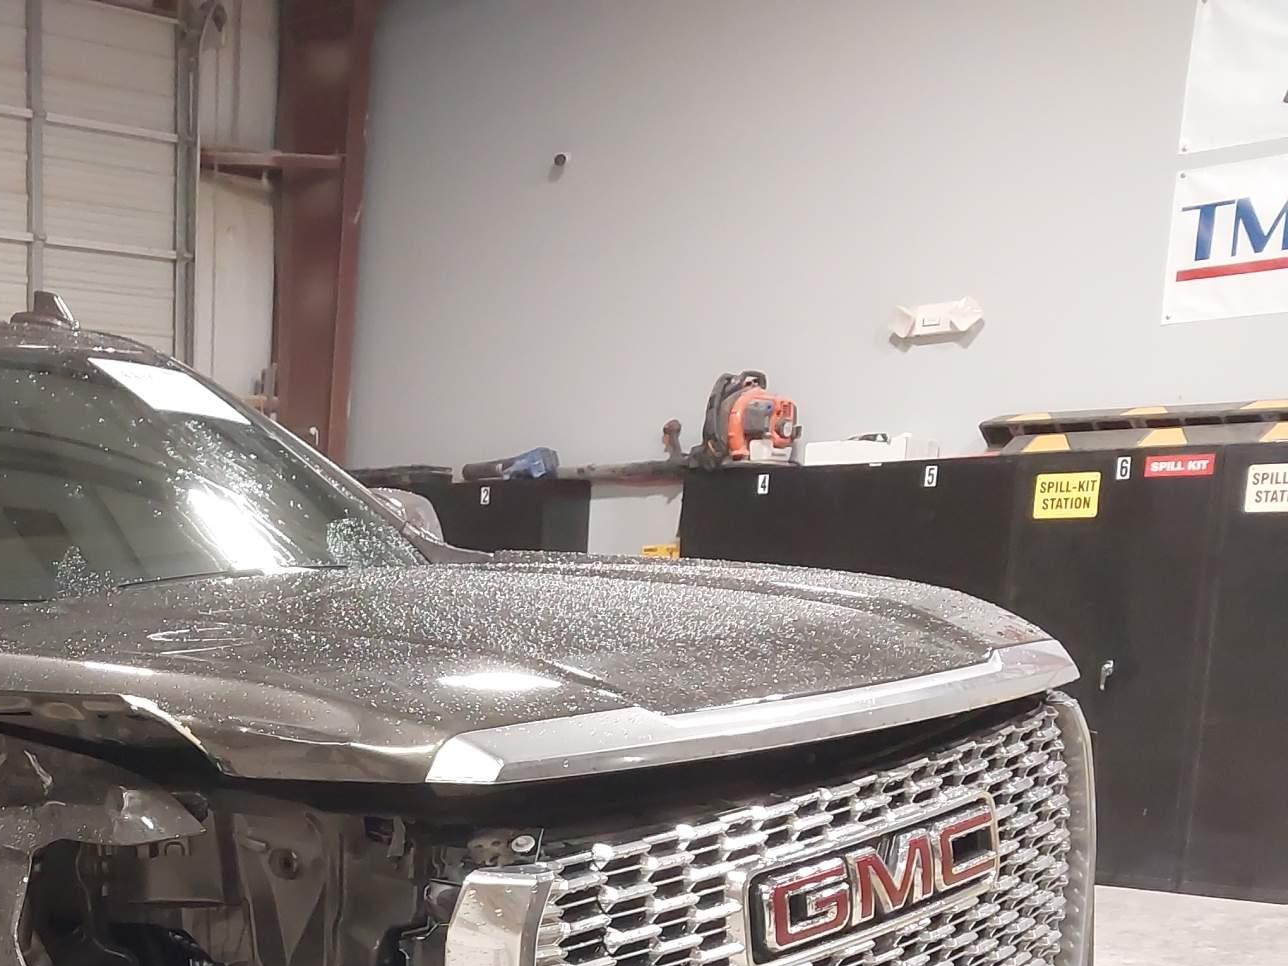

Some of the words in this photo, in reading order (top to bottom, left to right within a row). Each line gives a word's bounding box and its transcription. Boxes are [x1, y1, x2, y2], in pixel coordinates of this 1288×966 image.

[1182, 197, 1288, 261] TM
[1120, 459, 1129, 477] 6
[1150, 461, 1185, 472] SPILL
[1187, 459, 1210, 471] KIT
[760, 475, 767, 492] 4
[927, 467, 935, 485] 5
[1039, 479, 1098, 494] SPILL-KIT
[482, 488, 489, 503] 2
[1042, 497, 1091, 510] STATION
[760, 805, 998, 950] GMC
